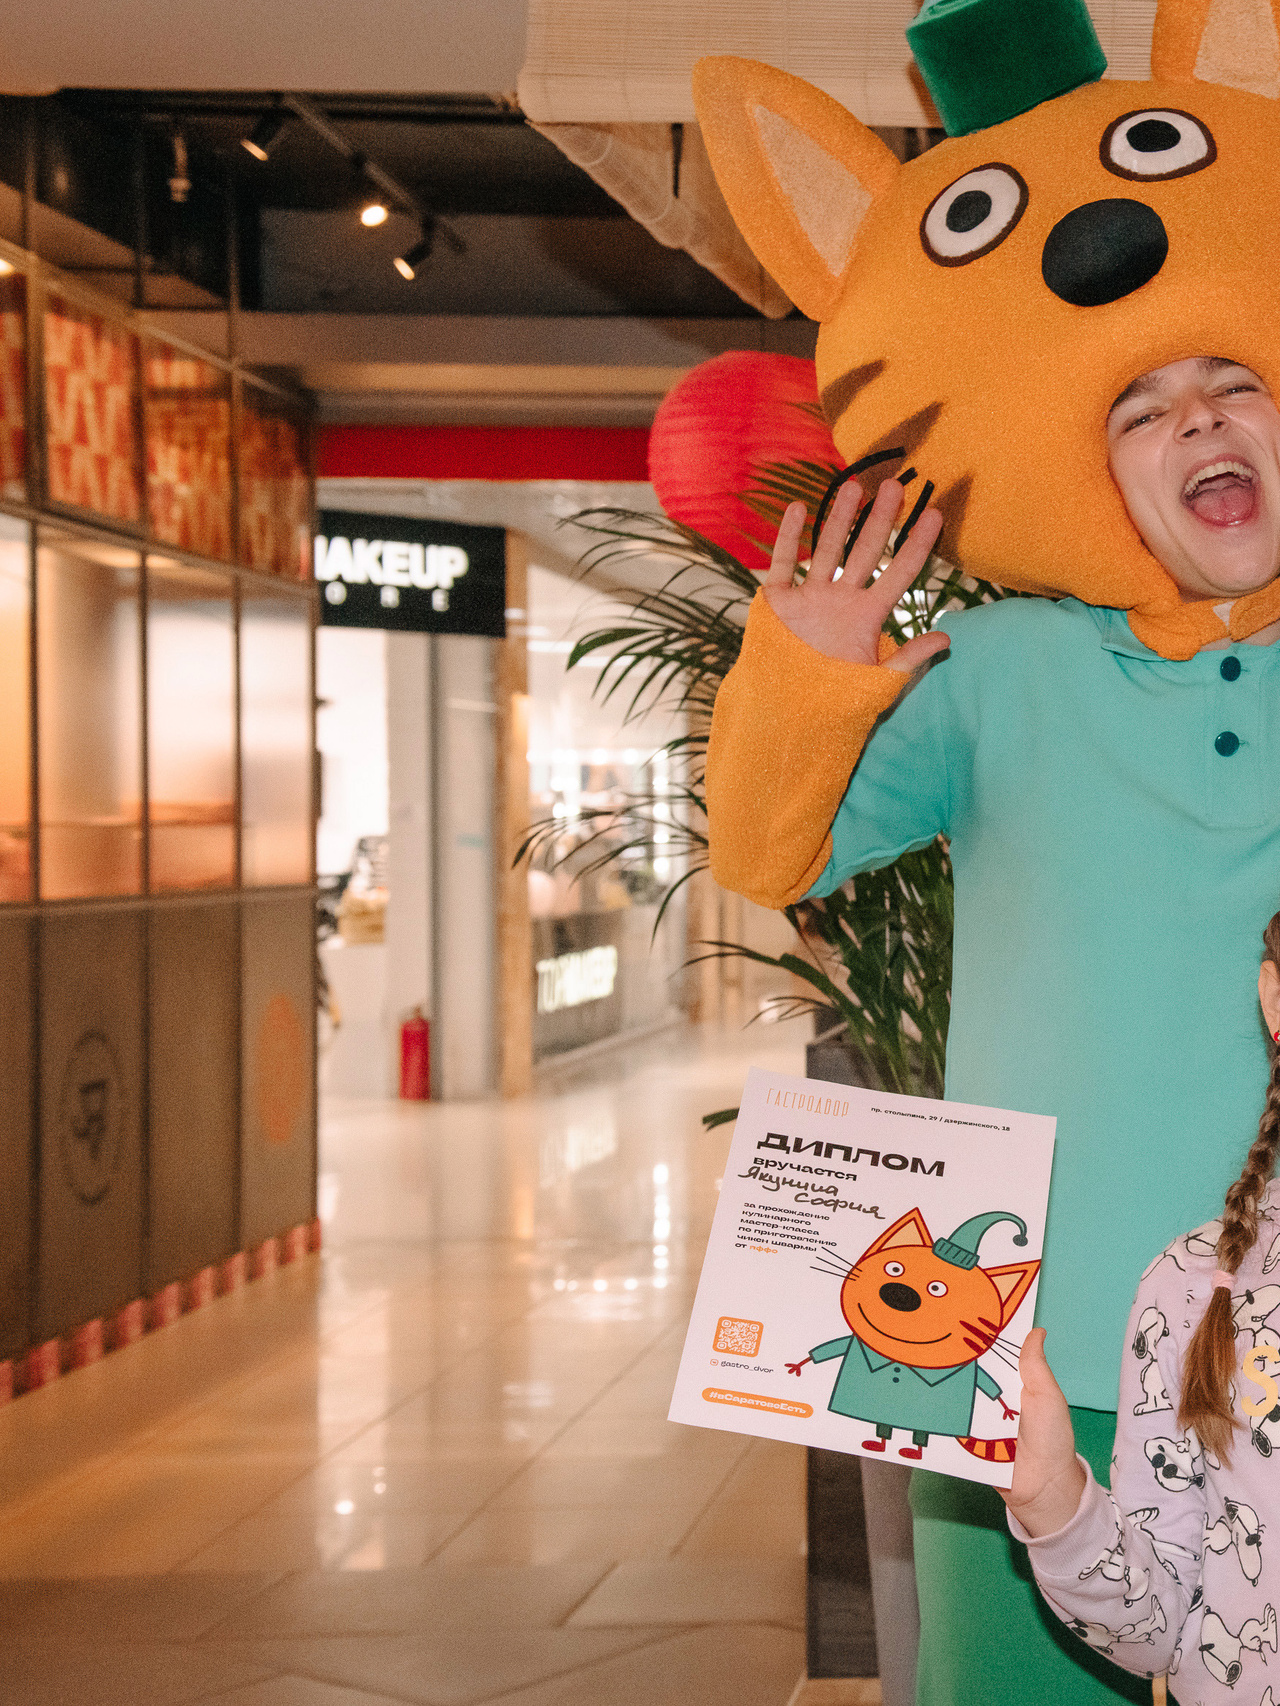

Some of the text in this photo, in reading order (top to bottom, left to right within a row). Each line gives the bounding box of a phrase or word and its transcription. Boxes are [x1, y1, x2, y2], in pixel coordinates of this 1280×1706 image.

[756, 1132, 946, 1177] ДИПЛОМ
[753, 1157, 858, 1182] вручается
[758, 1204, 830, 1221] прохождение
[794, 1192, 886, 1220] София
[740, 1218, 820, 1236] мастер-класса
[742, 1210, 812, 1226] кулинарного
[737, 1234, 817, 1252] чикен швармы
[753, 1228, 838, 1247] приготовлению
[720, 1360, 775, 1374] gastro_dvor
